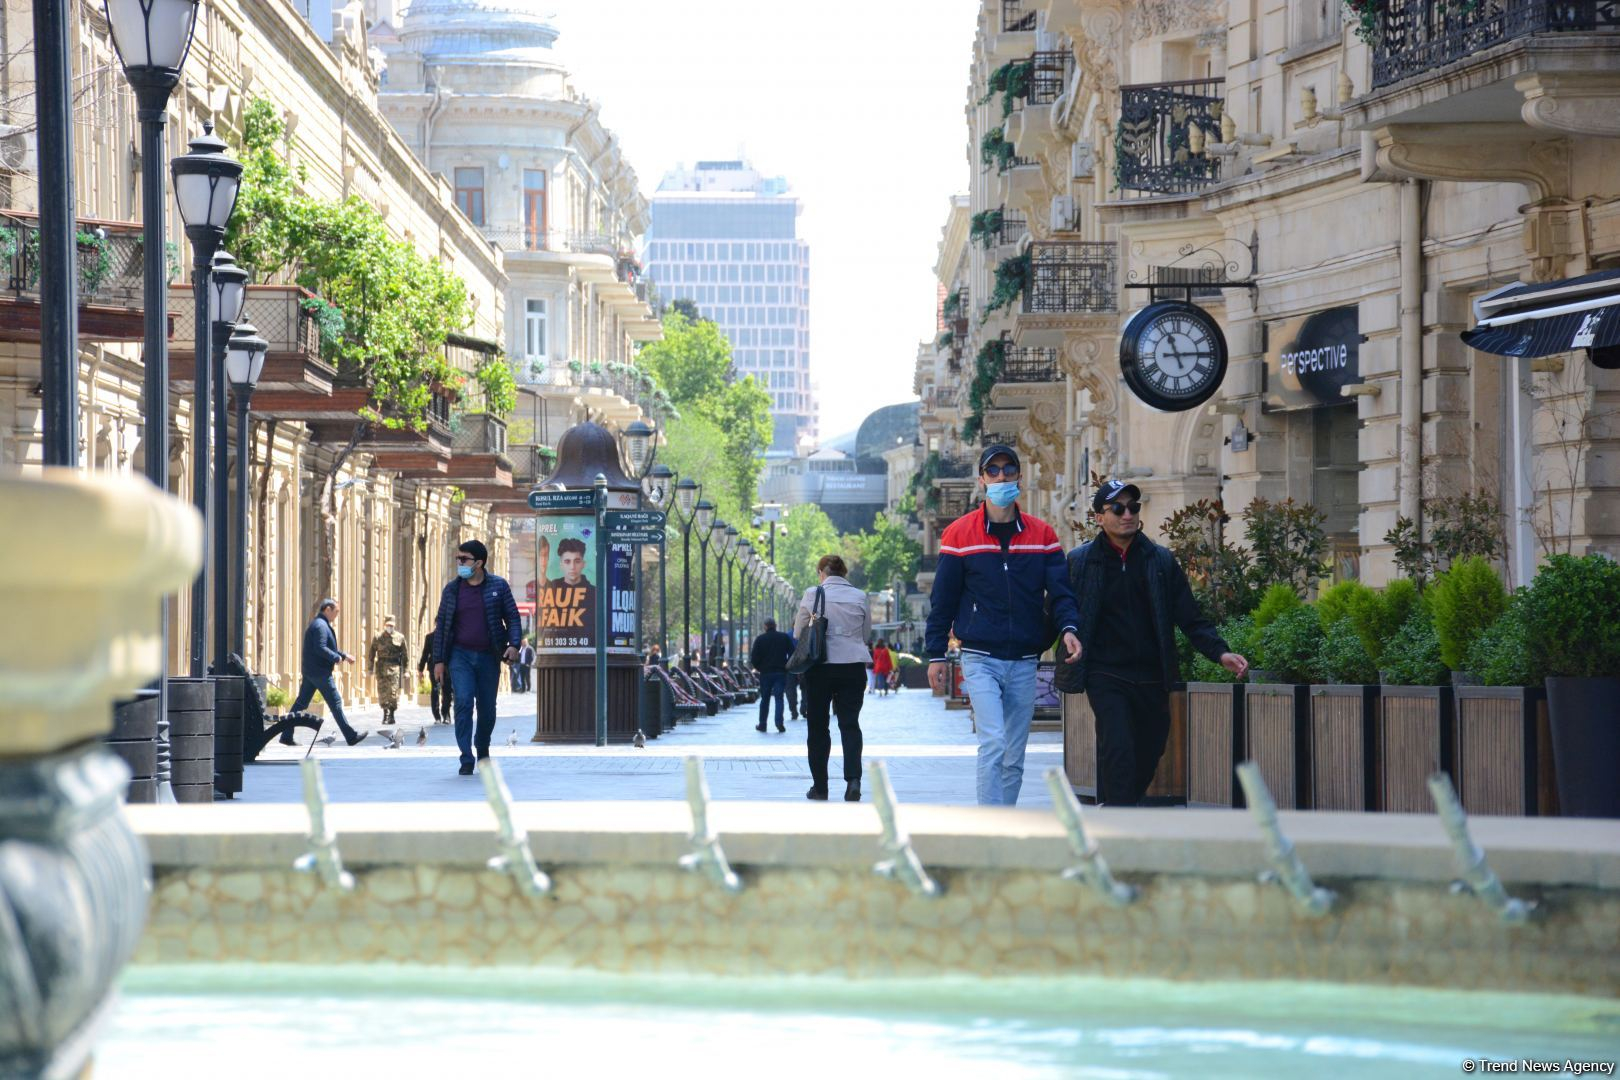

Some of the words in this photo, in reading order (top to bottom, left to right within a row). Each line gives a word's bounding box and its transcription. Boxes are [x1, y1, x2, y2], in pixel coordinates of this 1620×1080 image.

[612, 586, 636, 612] İLQA
[554, 637, 567, 646] 303
[568, 637, 578, 646] 35
[579, 637, 589, 646] 40
